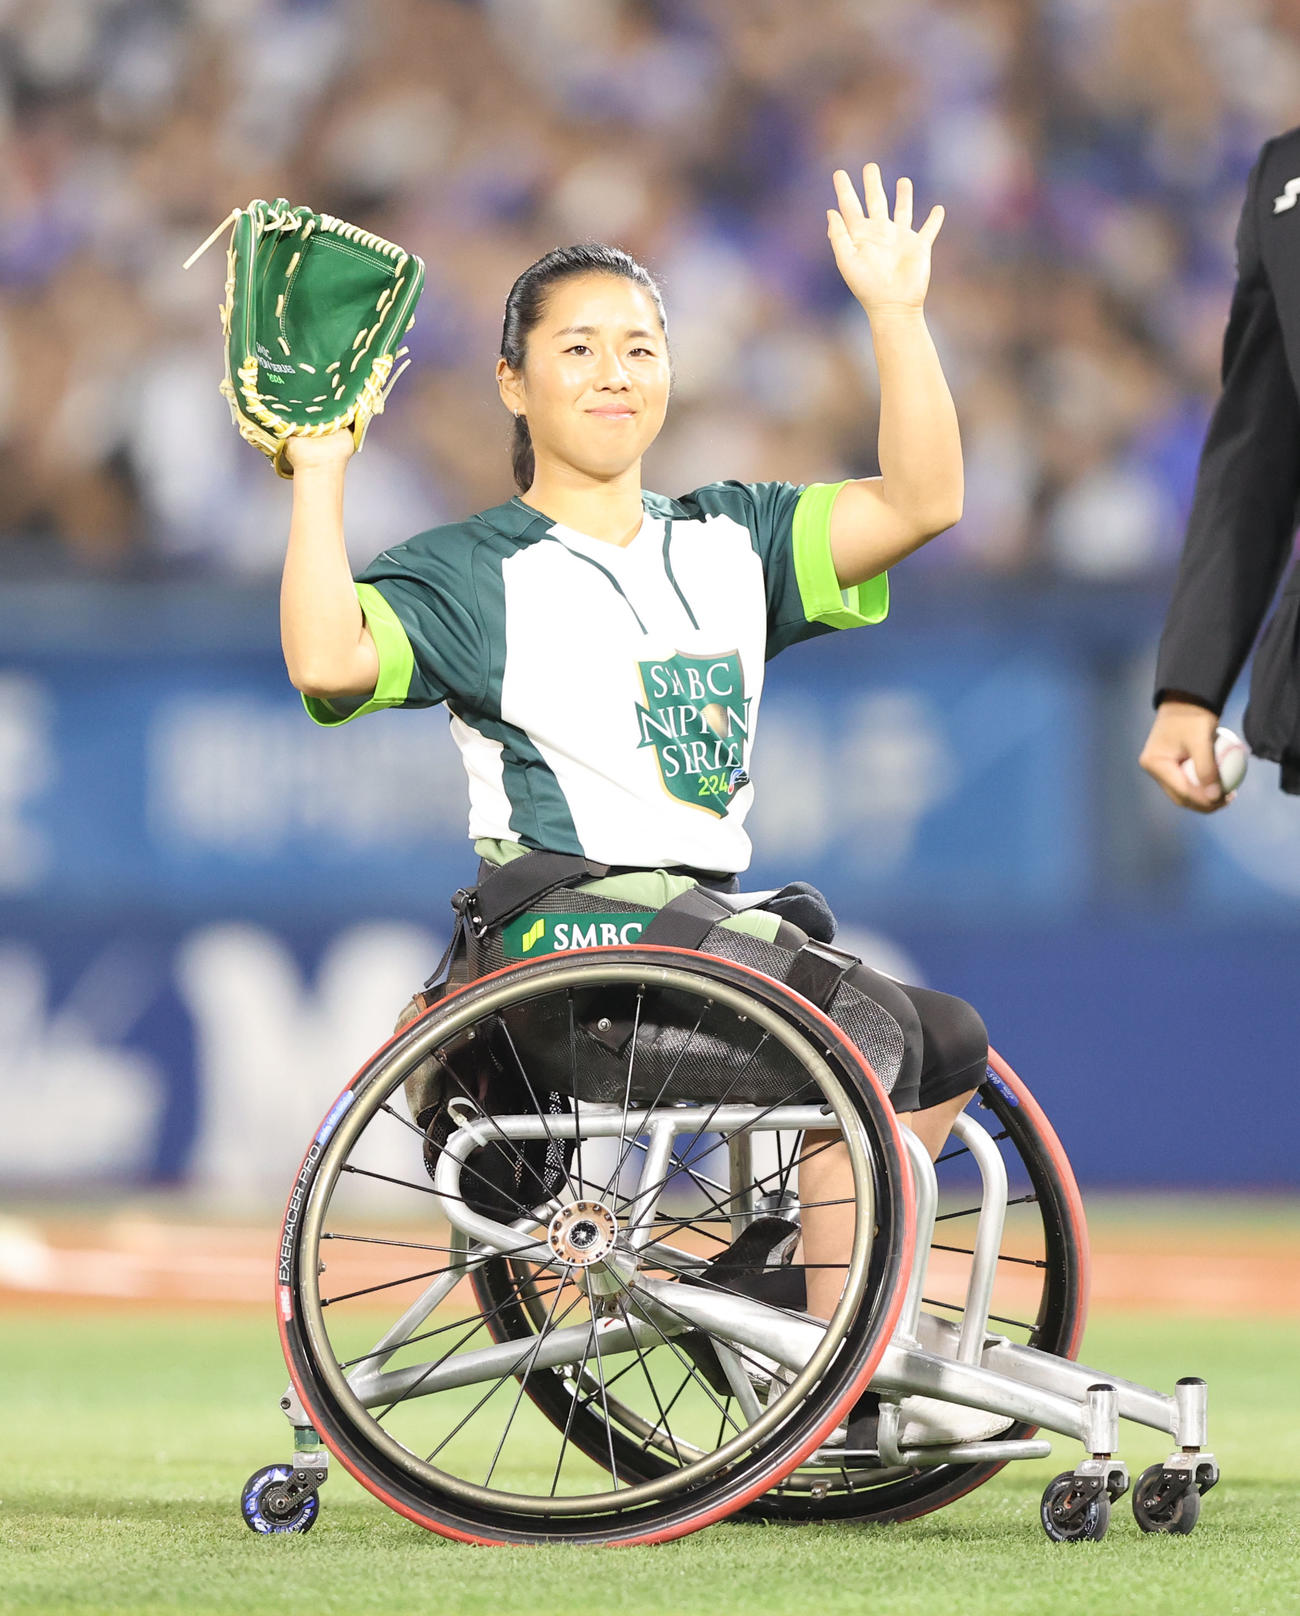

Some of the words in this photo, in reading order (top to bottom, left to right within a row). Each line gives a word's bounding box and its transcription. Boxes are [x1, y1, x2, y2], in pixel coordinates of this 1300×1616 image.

[553, 922, 643, 951] SMBC
[278, 1185, 305, 1283] EXERACER
[298, 1144, 321, 1184] PRO
